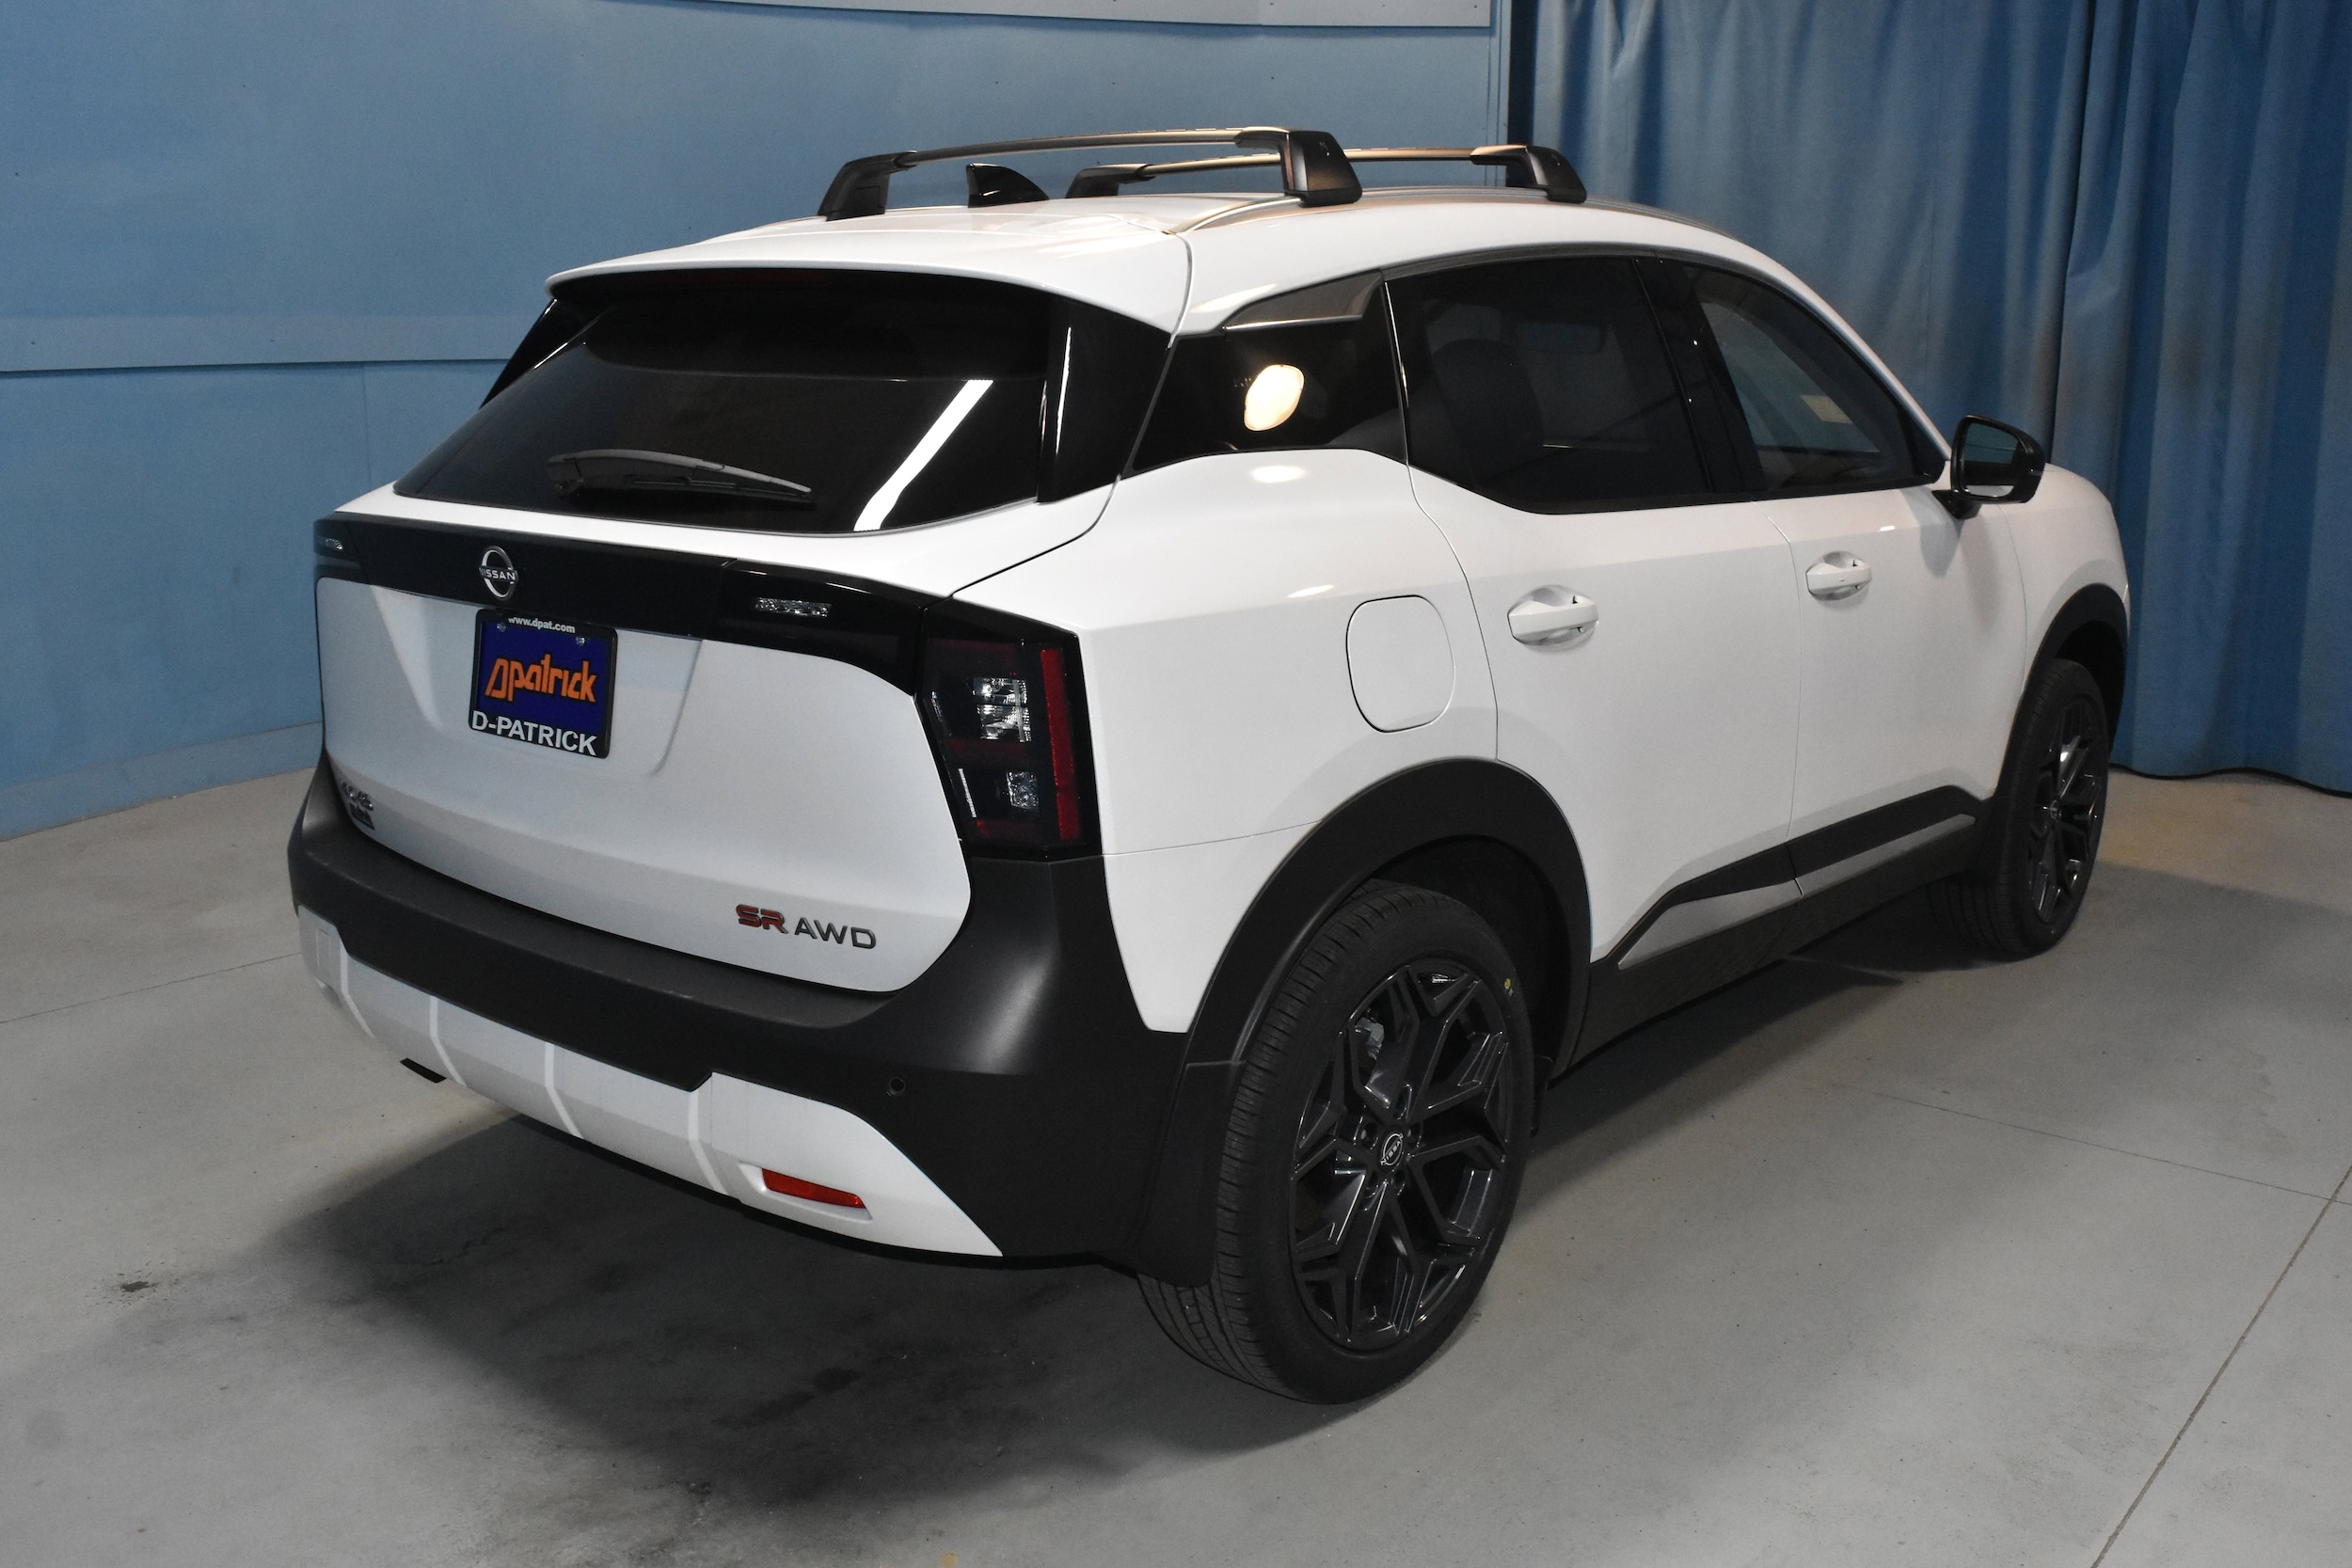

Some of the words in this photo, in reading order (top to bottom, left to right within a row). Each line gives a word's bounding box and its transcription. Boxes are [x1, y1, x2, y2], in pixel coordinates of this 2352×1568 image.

[479, 567, 516, 580] NISSAN
[508, 616, 576, 634] www.dpat.com
[471, 710, 597, 756] D-PATRICK
[736, 904, 788, 934] SR
[794, 917, 876, 949] AWD
